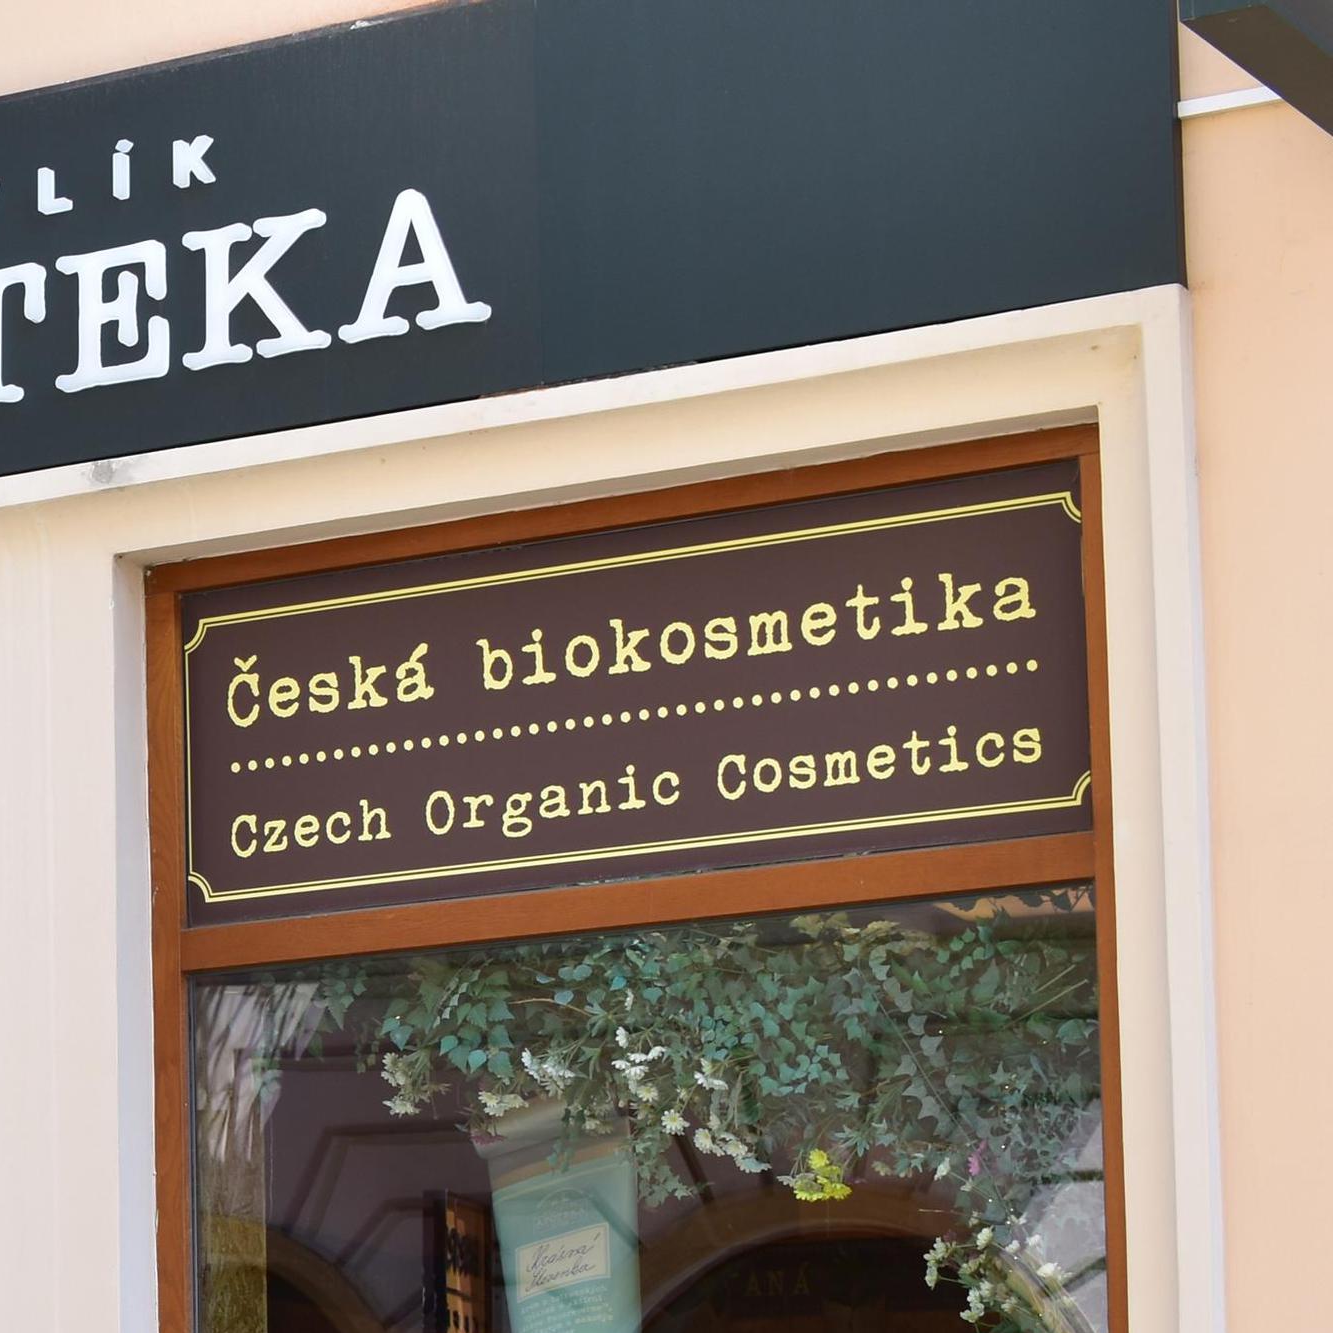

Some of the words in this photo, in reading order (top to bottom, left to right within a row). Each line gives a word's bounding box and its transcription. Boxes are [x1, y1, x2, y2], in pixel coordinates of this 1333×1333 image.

[226, 642, 435, 728] Česká
[477, 571, 1037, 692] biokosmetika
[230, 799, 393, 860] Czech
[425, 763, 682, 840] Organic
[717, 724, 1044, 800] Cosmetics
